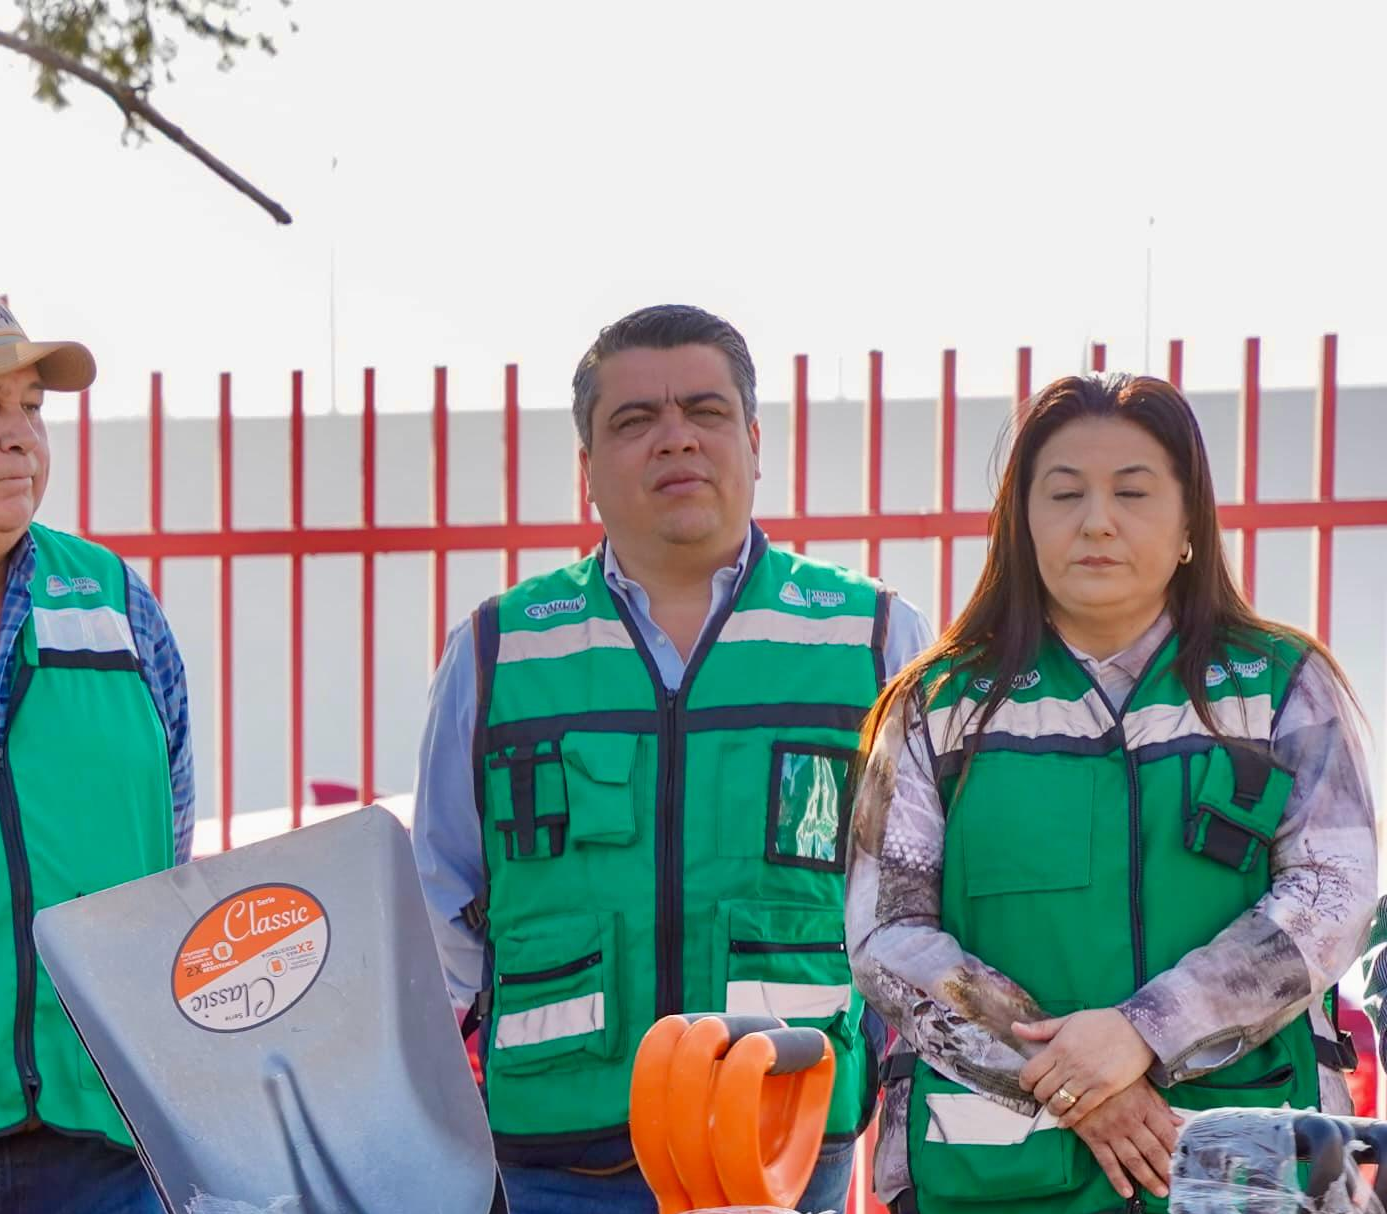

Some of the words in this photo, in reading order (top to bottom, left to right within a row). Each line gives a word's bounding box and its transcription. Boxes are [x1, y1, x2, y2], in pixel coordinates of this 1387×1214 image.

[256, 896, 275, 906] Serie
[223, 899, 310, 942] Classic
[296, 940, 315, 954] 2X
[186, 964, 204, 978] 2X
[190, 977, 276, 1018] Classic
